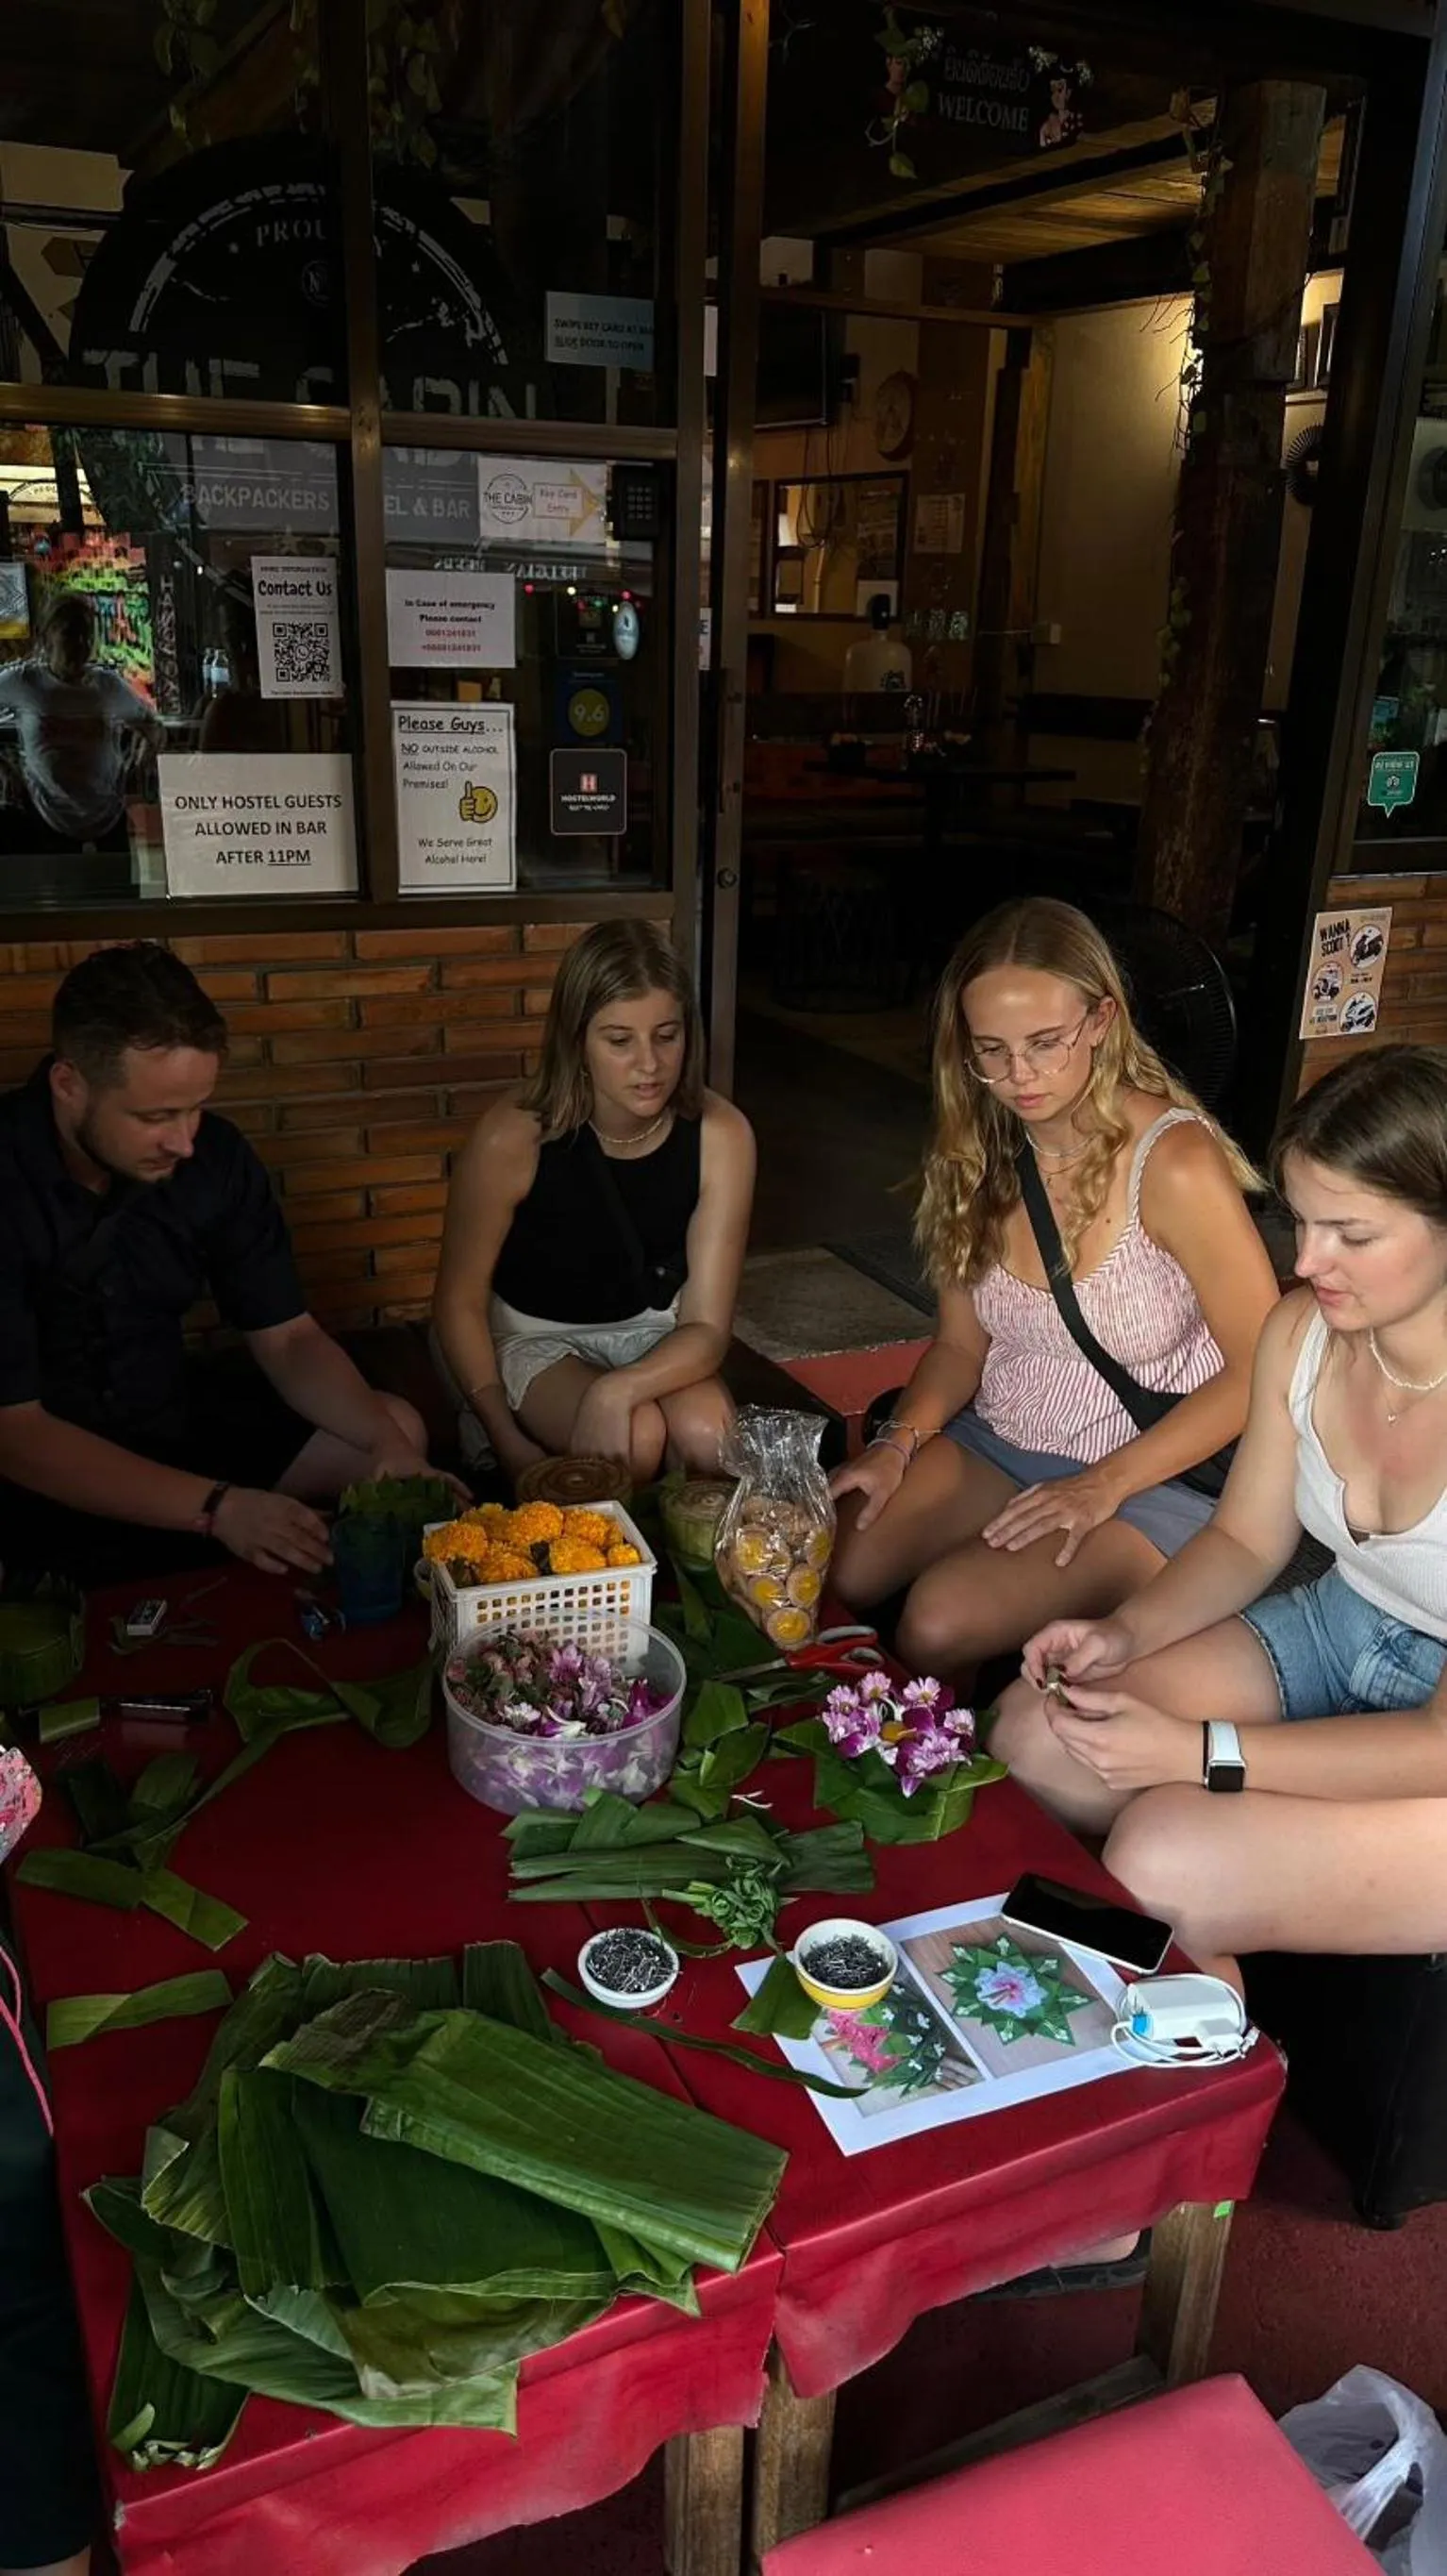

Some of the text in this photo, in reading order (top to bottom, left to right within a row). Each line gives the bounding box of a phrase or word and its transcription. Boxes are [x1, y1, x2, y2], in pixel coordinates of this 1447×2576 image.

[937, 92, 1030, 131] WELCOME
[182, 483, 330, 512] BACKPACKERS
[432, 504, 472, 519] BAR
[483, 491, 503, 504] THE
[258, 579, 332, 597] Contact Us
[450, 601, 495, 611] emergency
[420, 614, 448, 623] Please
[574, 708, 605, 723] 9.6
[398, 715, 444, 733] Please
[401, 743, 499, 755] NO OUTSIDE ALCOHOL
[403, 761, 478, 771] Allowed On Our
[402, 778, 449, 790] Premises!
[175, 795, 342, 810] ONLY HOSTEL GUESTS
[195, 822, 327, 836] ALLOWED IN BAR
[418, 837, 492, 847] We Serve Great
[216, 849, 311, 866] AFTER 11PM
[424, 854, 459, 864] Alcohol
[1320, 918, 1350, 942] WANNA
